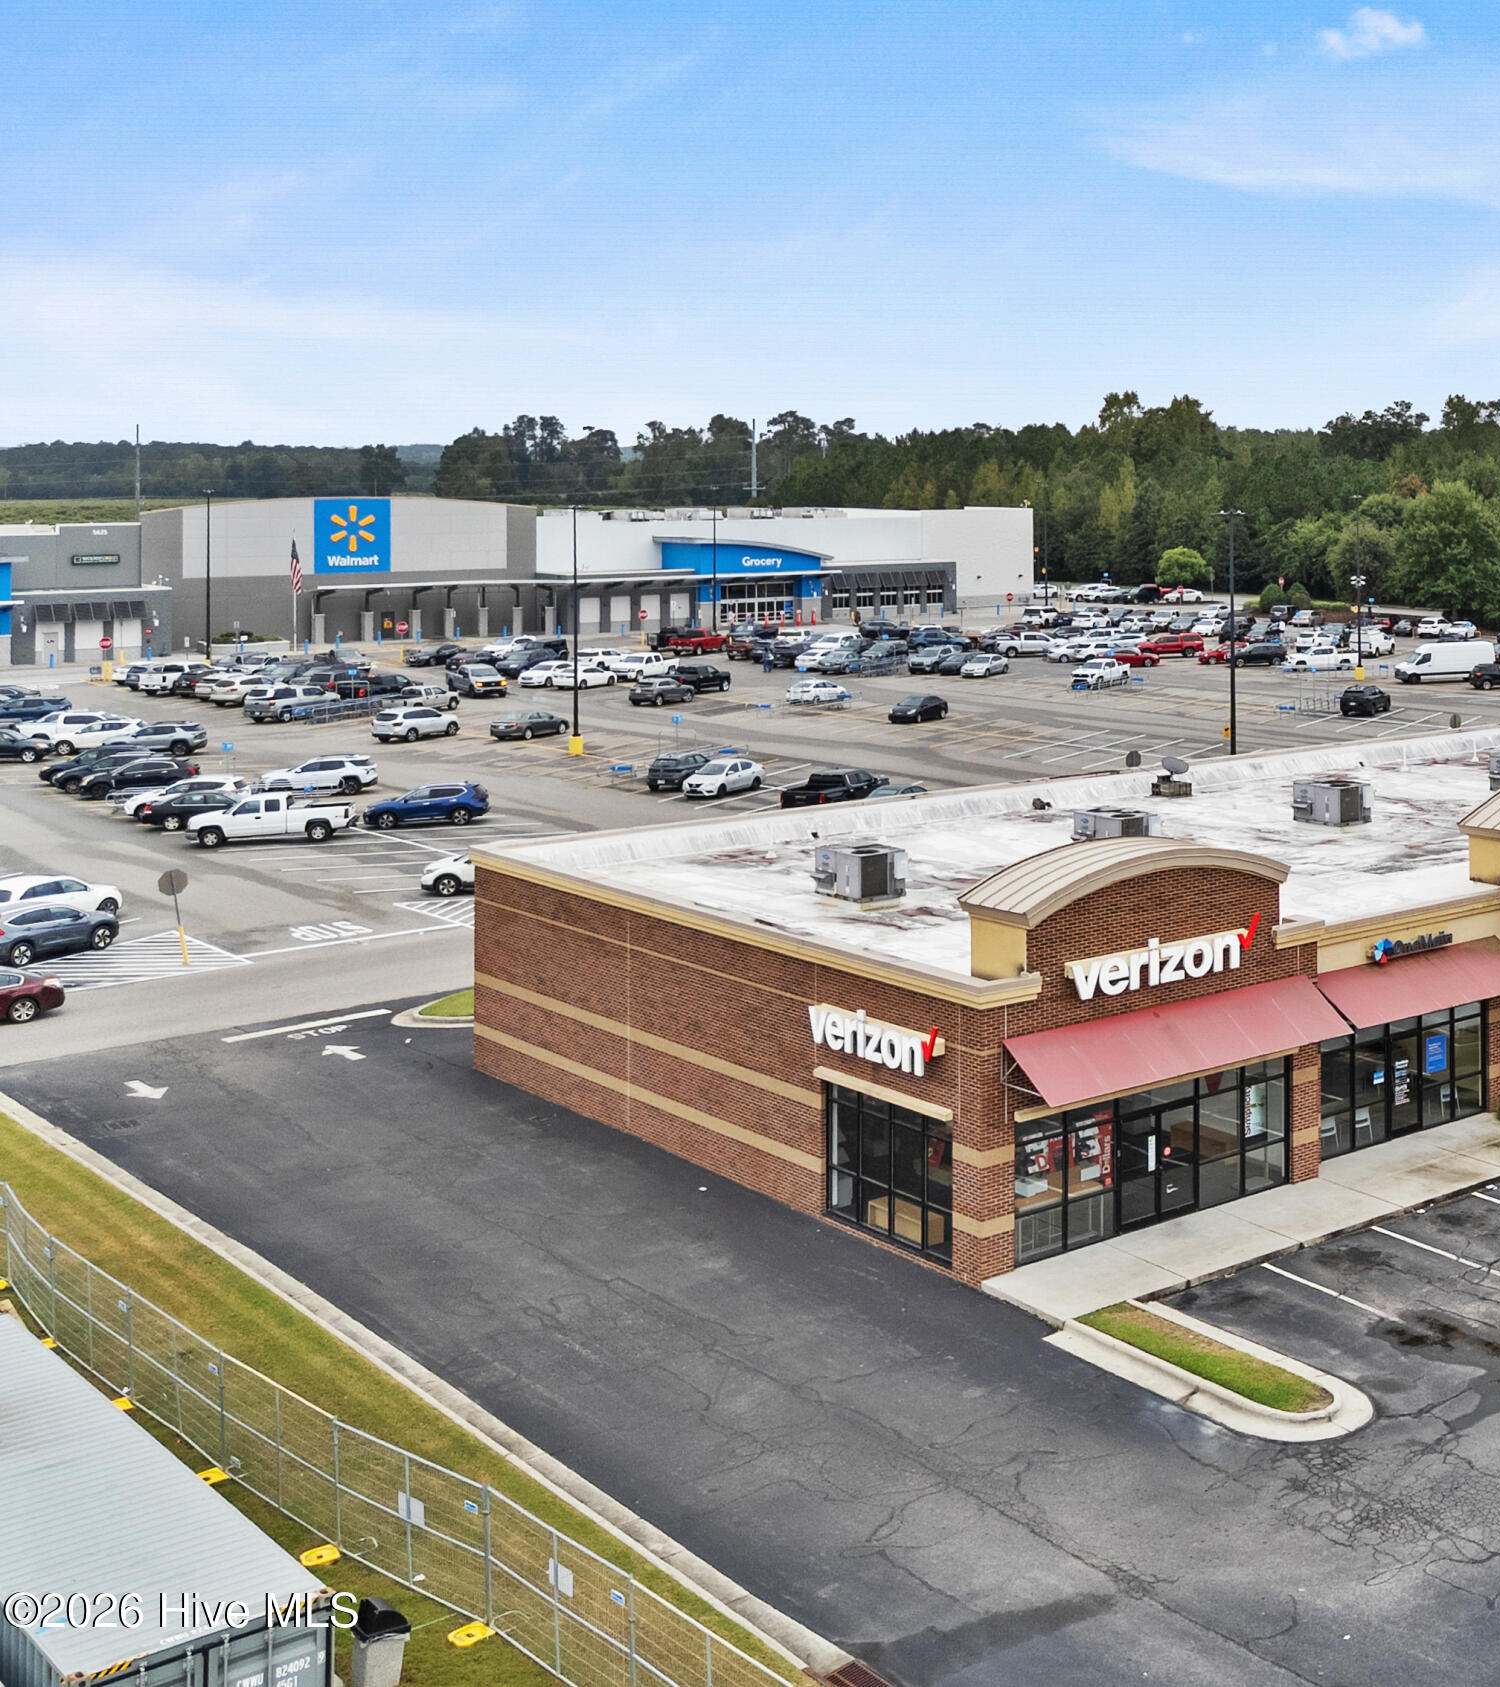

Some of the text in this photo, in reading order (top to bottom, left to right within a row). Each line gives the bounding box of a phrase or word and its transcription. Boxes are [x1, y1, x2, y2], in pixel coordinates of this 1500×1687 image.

[327, 554, 379, 567] Walmart
[742, 556, 782, 568] Grocery
[289, 920, 374, 942] STOP
[1393, 931, 1453, 954] OneMain
[1071, 933, 1241, 1000] verizon
[287, 1023, 351, 1041] STOP
[808, 1005, 925, 1077] verizon
[275, 1656, 311, 1679] 824092
